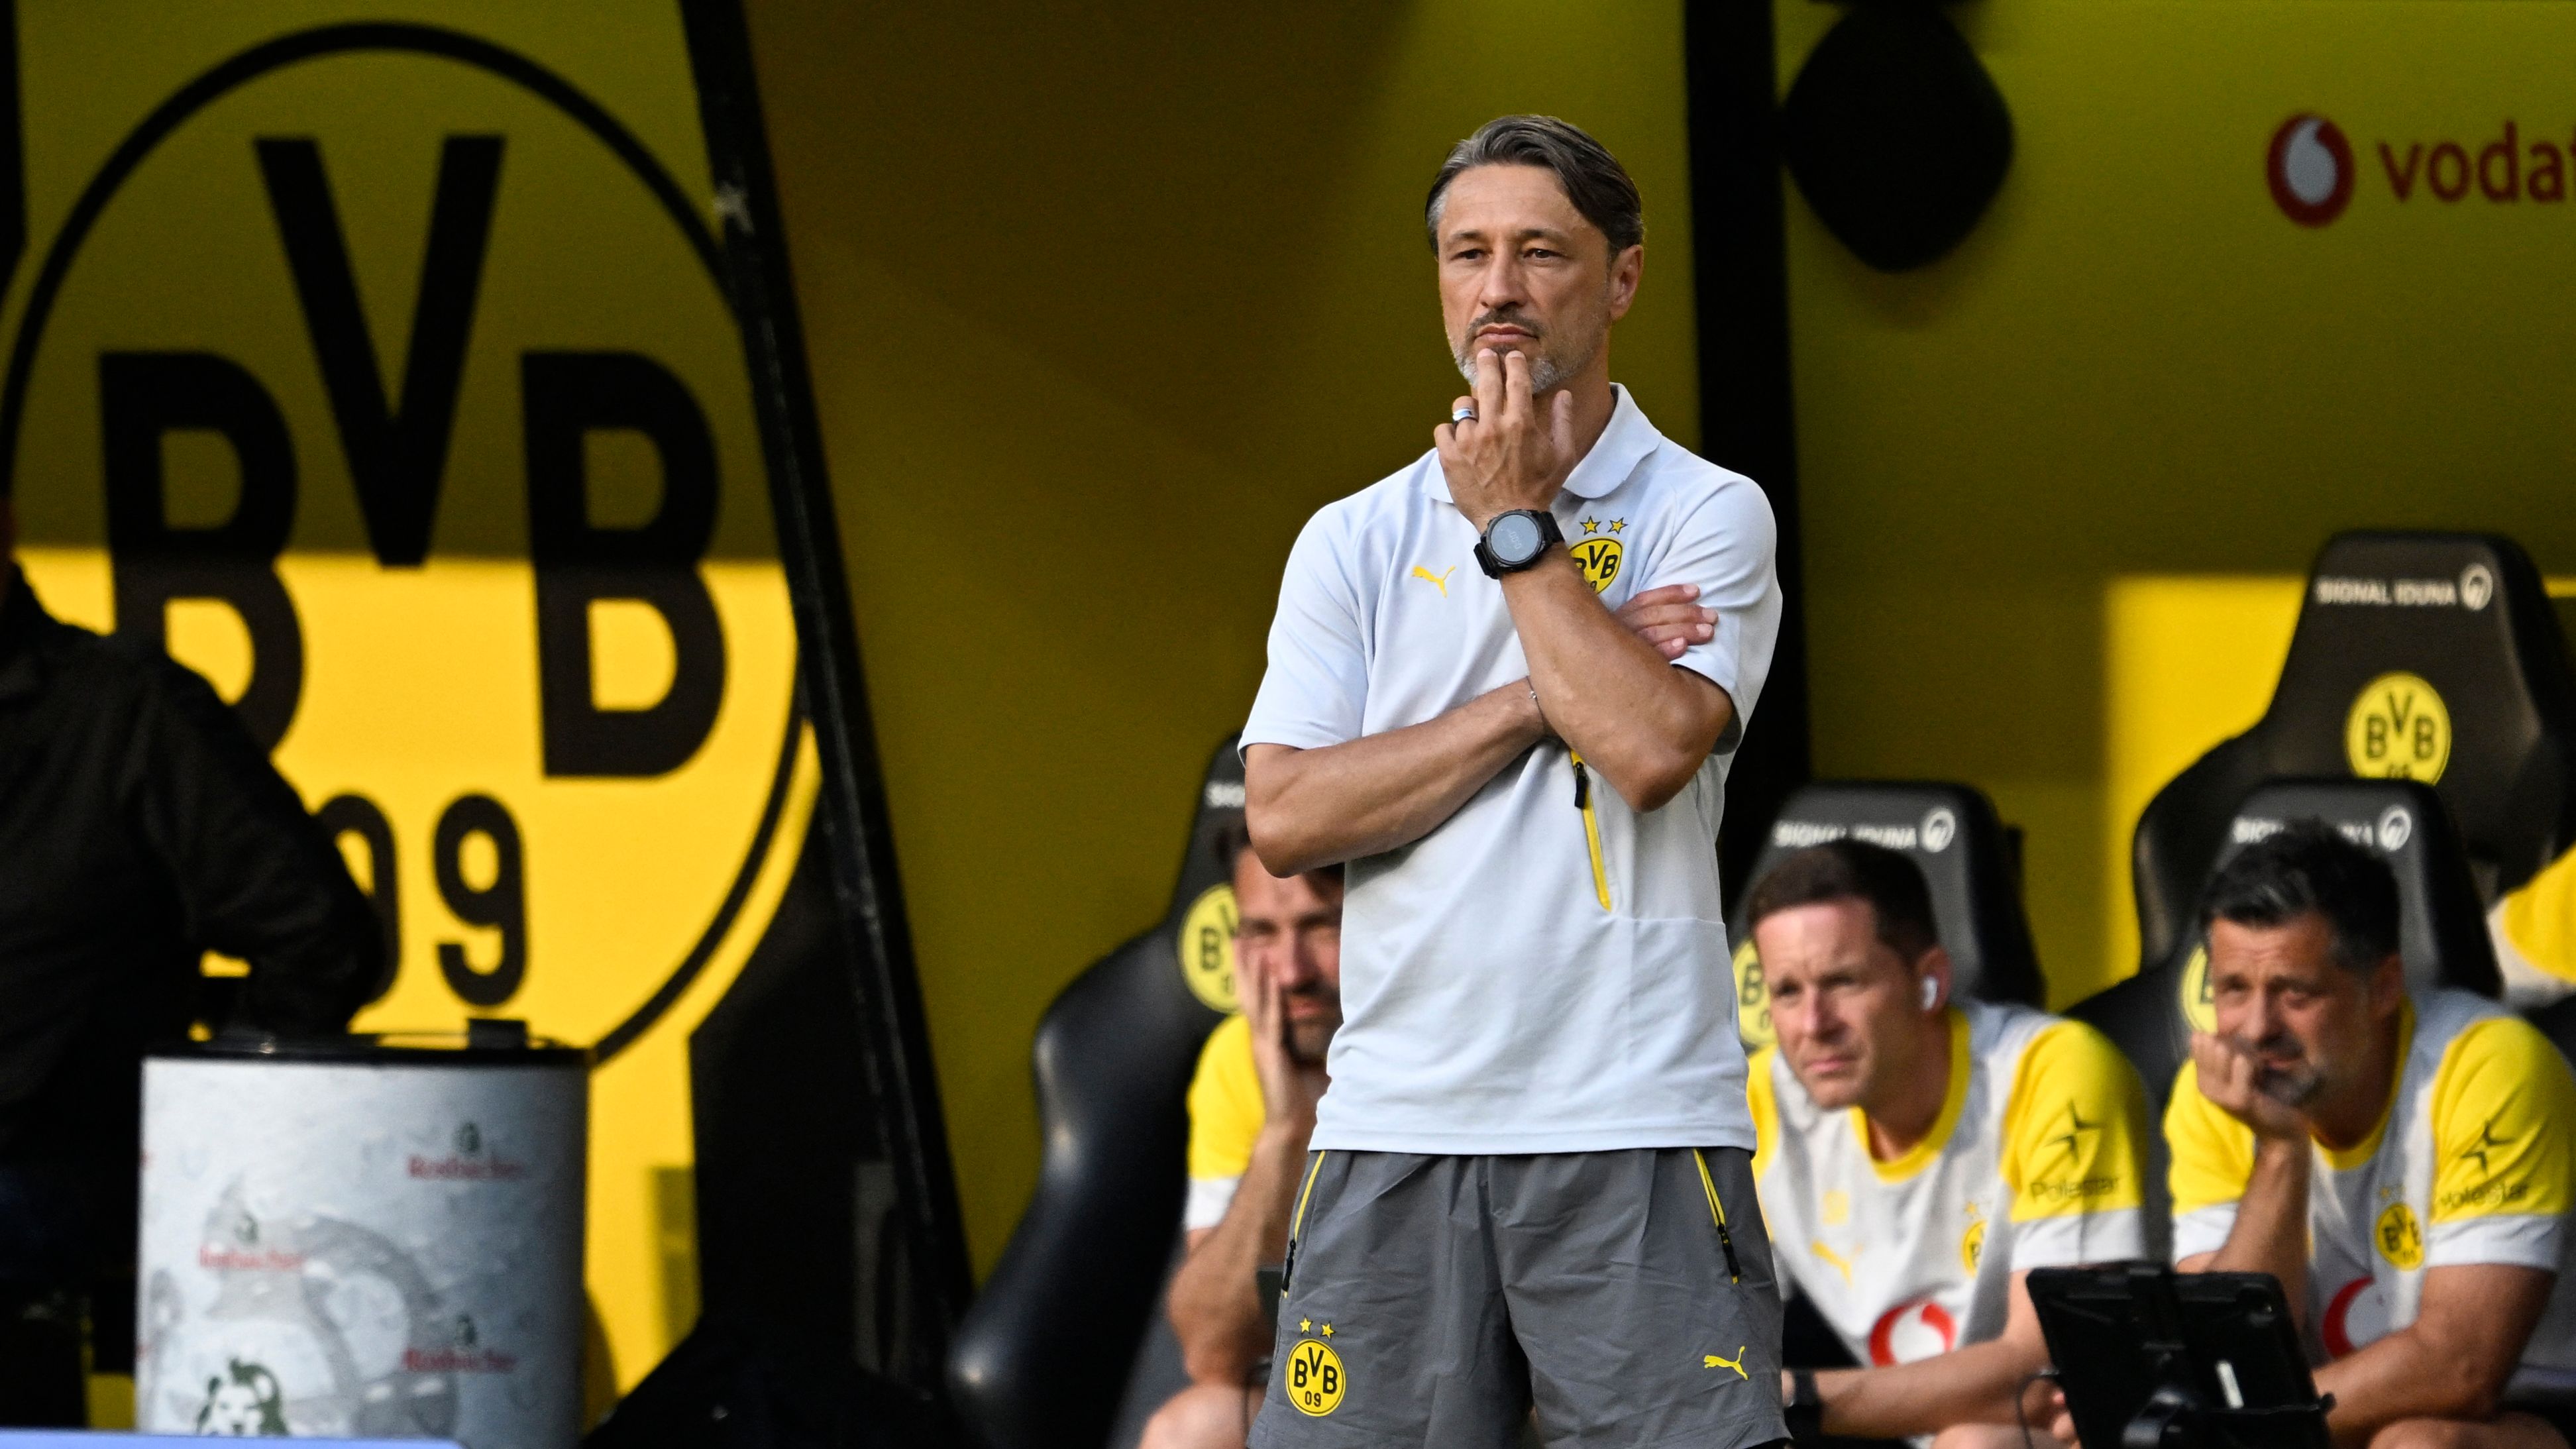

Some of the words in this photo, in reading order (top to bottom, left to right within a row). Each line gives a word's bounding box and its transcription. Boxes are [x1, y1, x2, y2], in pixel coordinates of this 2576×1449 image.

[2378, 119, 2576, 203] voda
[98, 136, 730, 778] BVB
[2366, 690, 2435, 760] BVB
[1294, 1347, 1338, 1395] BVB
[1305, 1391, 1321, 1407] 09
